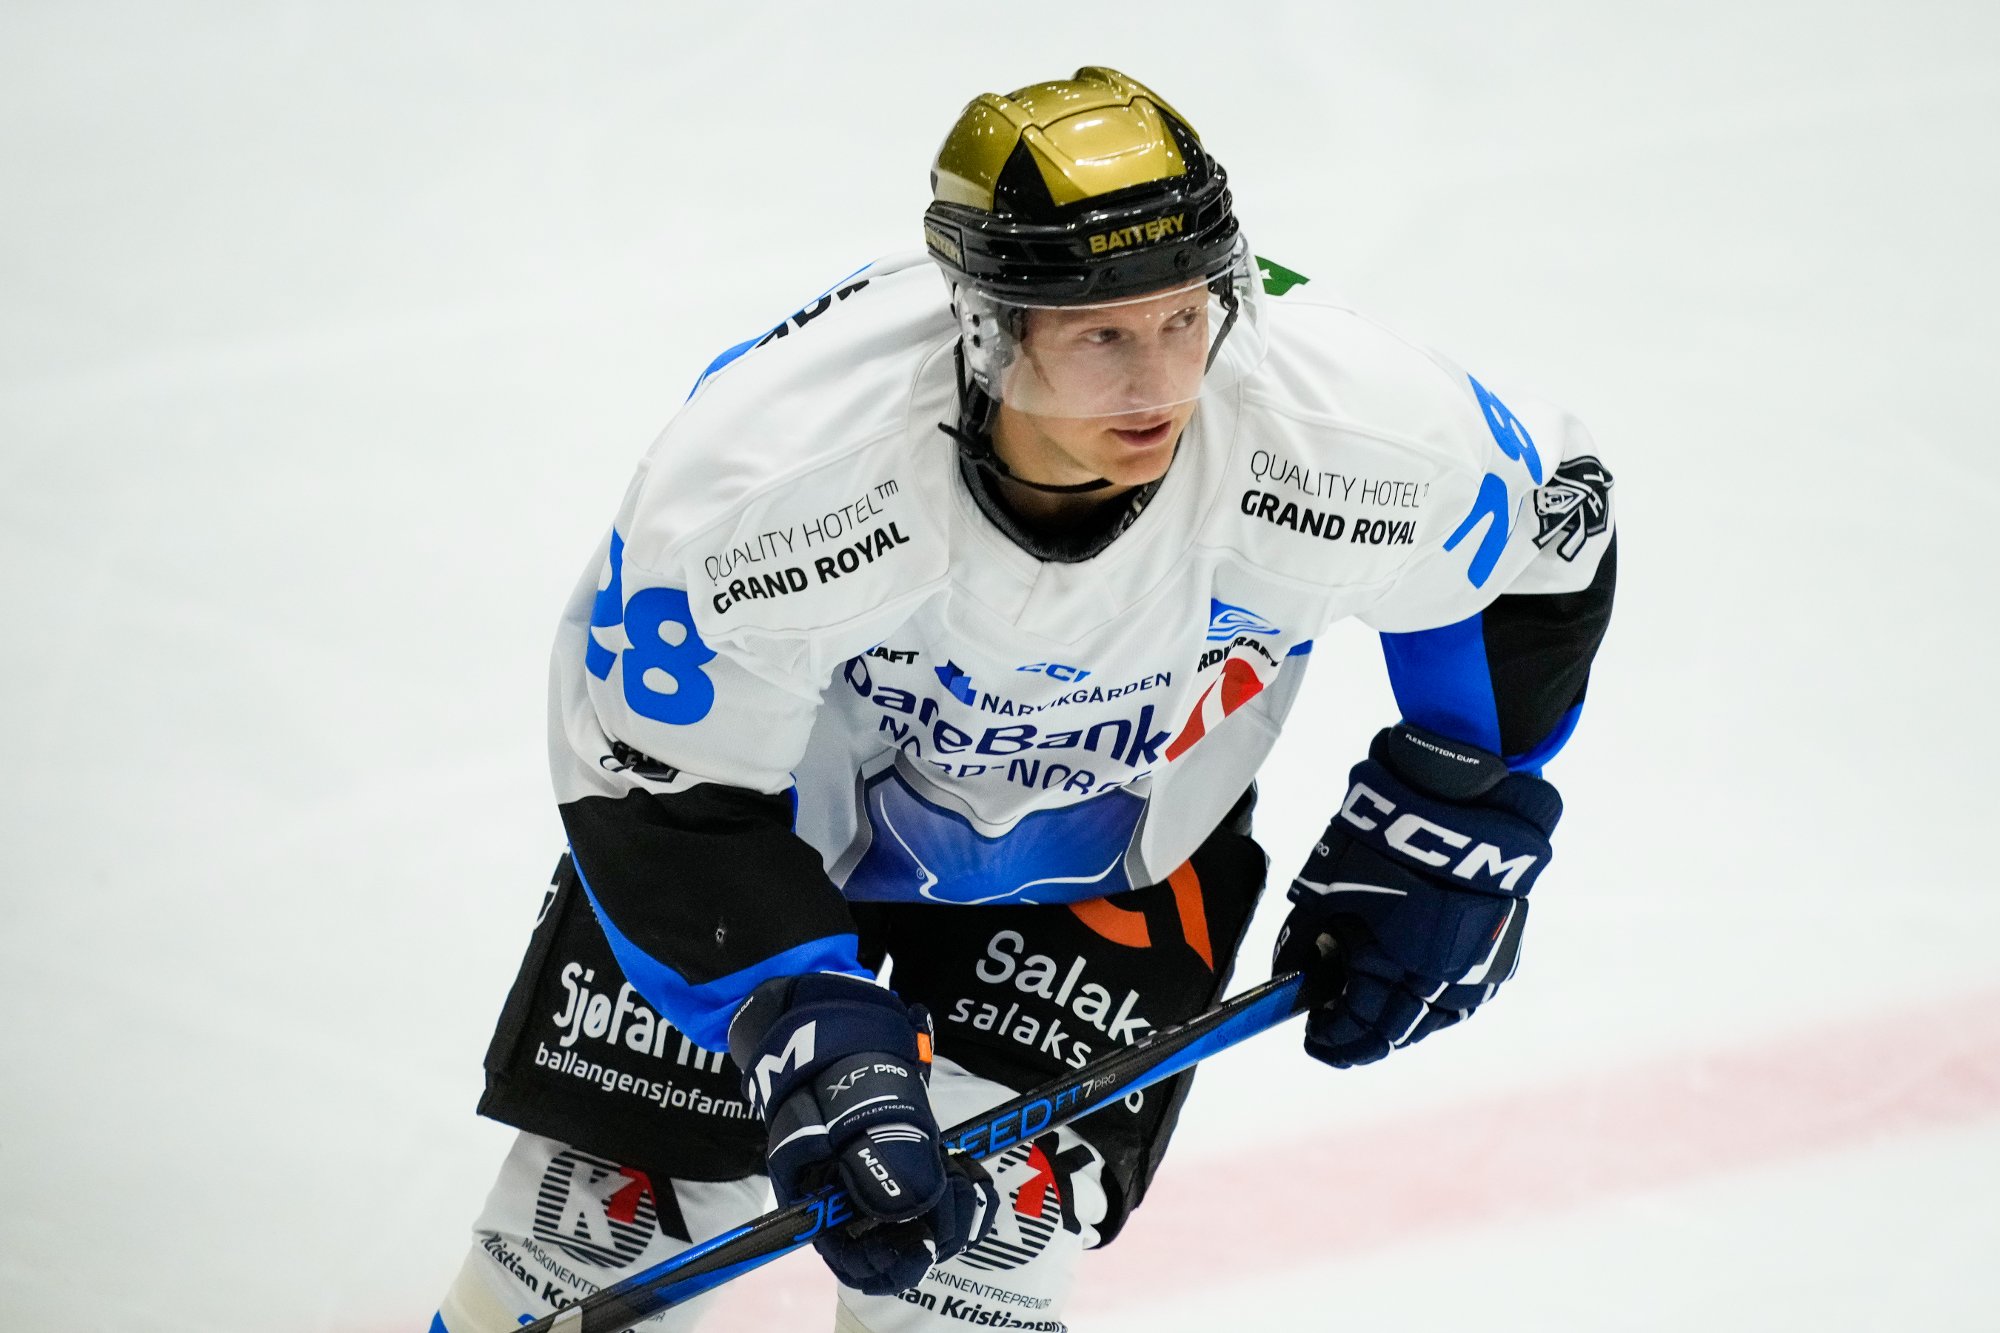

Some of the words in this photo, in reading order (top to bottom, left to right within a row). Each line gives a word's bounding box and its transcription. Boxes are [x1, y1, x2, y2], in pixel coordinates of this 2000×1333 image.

[1089, 212, 1184, 255] BATTERY
[1250, 449, 1356, 499] QUALITY
[1240, 488, 1346, 542] GRAND
[1350, 517, 1417, 547] ROYAL
[704, 526, 794, 587] QUALITY
[712, 566, 809, 615] GRAND
[814, 521, 911, 584] ROYAL
[980, 671, 1172, 717] NARVIKGÅRDEN
[1405, 732, 1456, 758] FLEXMOTION
[1456, 752, 1480, 766] CUFF
[1340, 782, 1538, 891] CCM
[975, 929, 1158, 1046] Salak
[826, 1065, 870, 1102] XF
[873, 1063, 908, 1078] PRO
[857, 1147, 901, 1198] CCM
